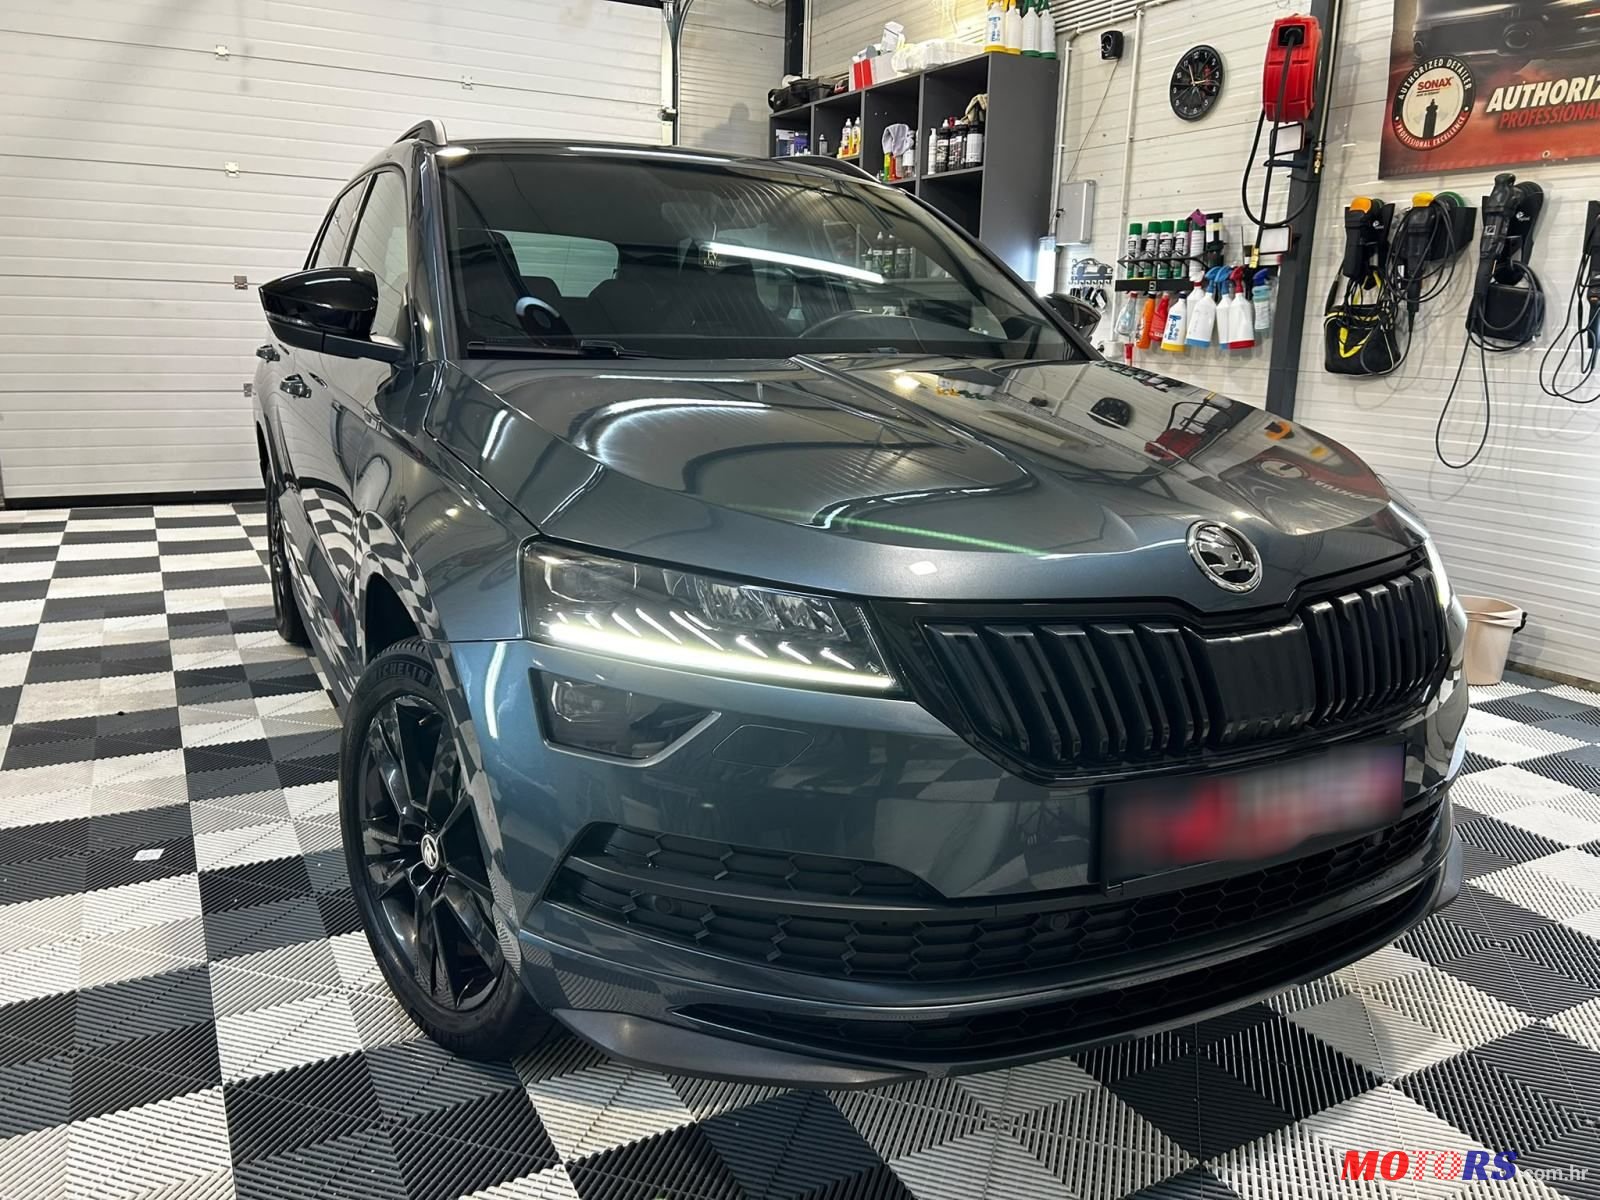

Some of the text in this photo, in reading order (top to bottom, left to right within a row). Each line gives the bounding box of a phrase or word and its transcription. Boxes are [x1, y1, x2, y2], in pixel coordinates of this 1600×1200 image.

[1398, 58, 1472, 100] AUTHORIZED DETAILER
[1417, 77, 1452, 91] SONAX
[1396, 116, 1465, 147] PROFESSIONAL EXCELLENCE
